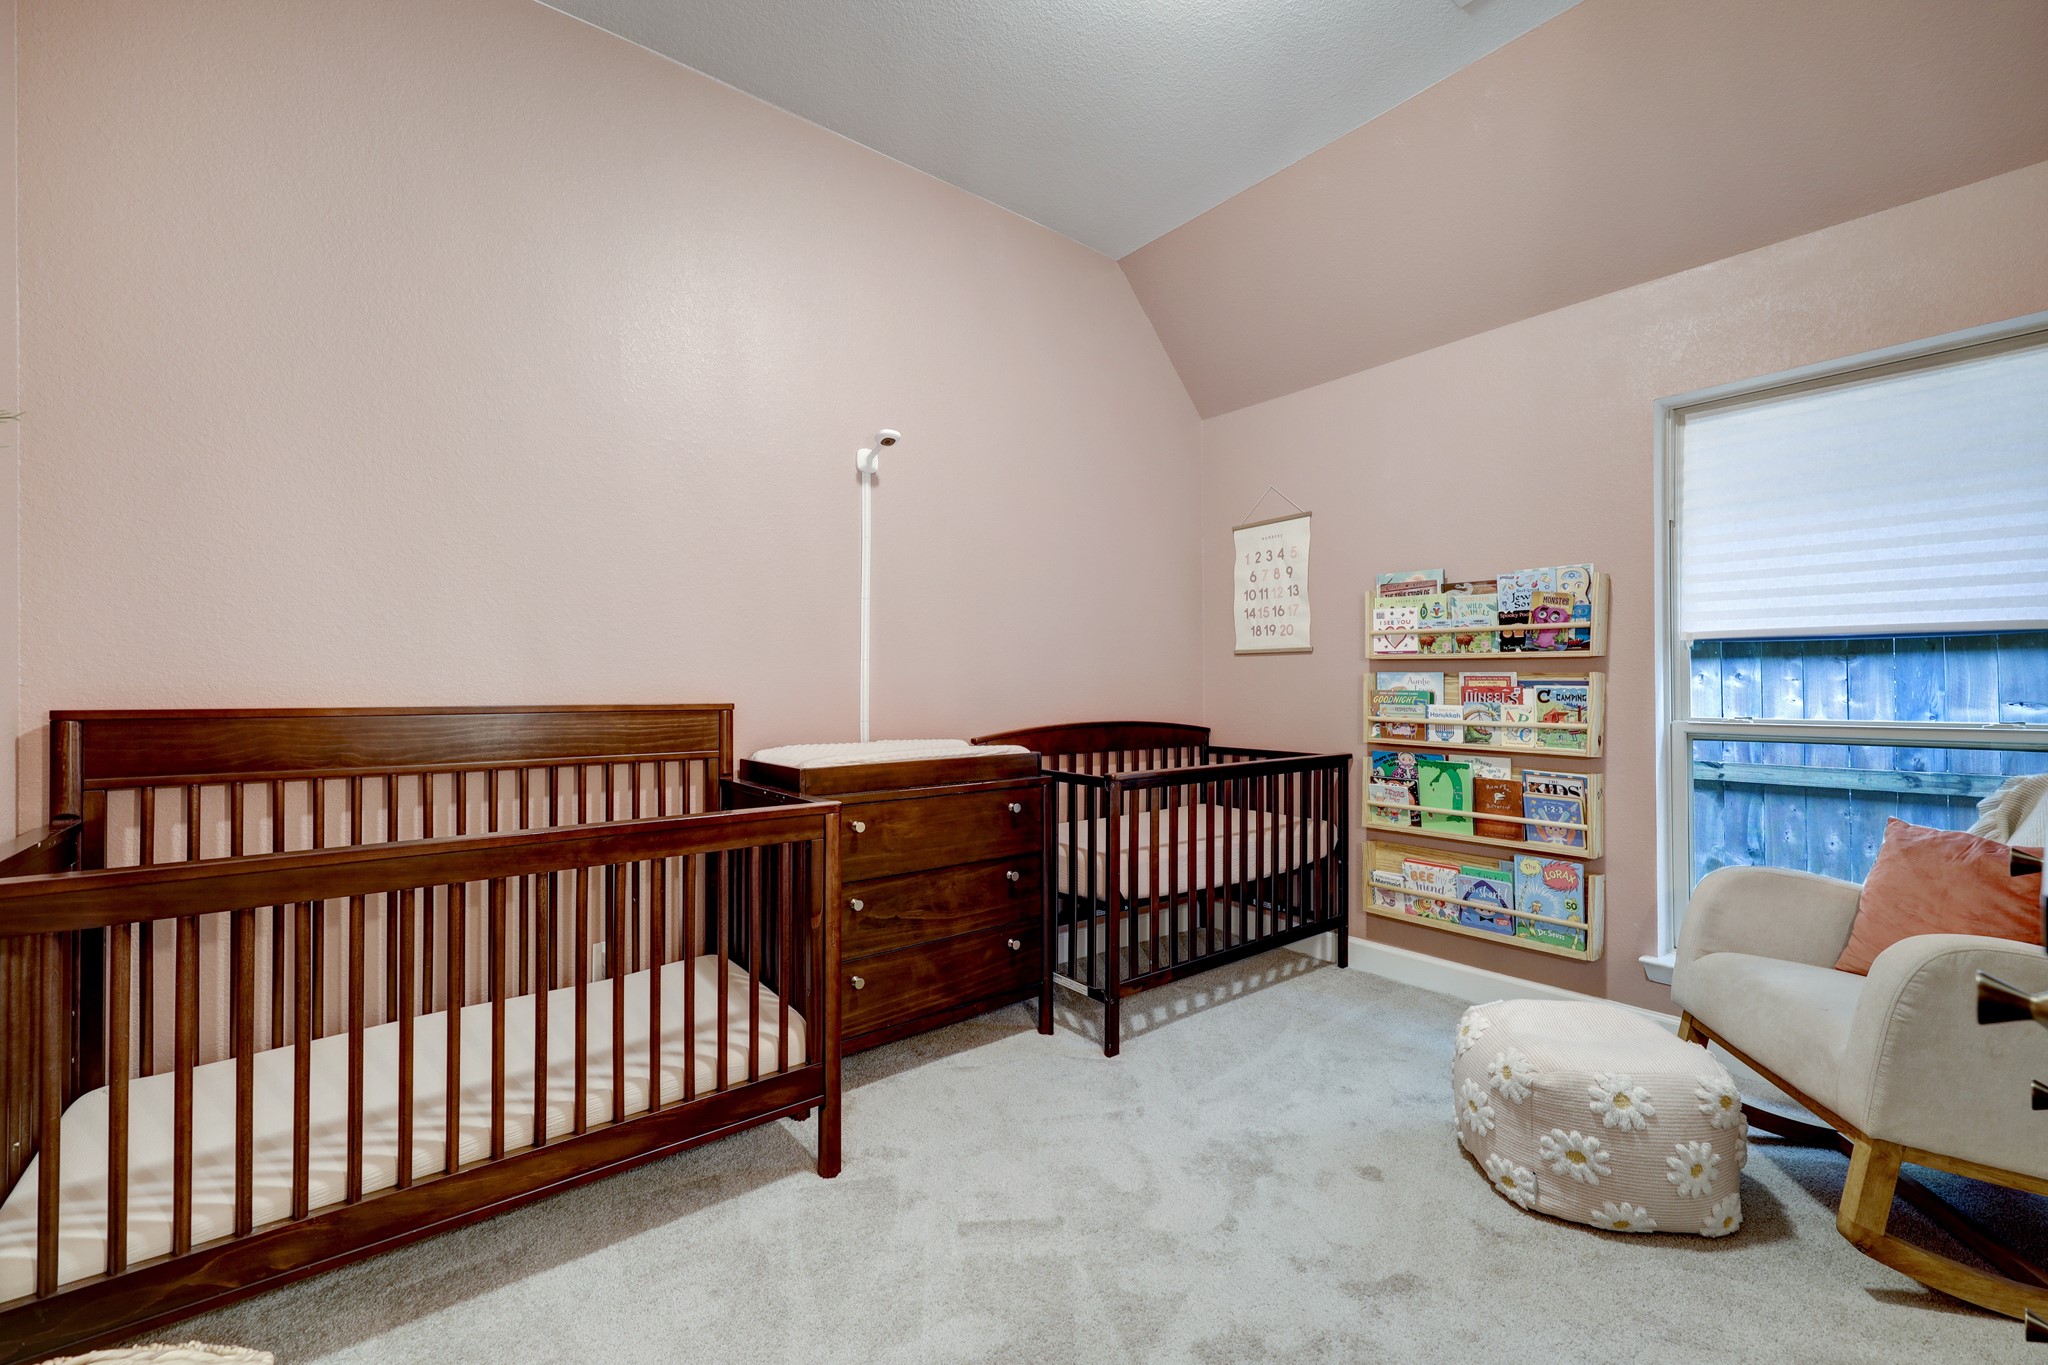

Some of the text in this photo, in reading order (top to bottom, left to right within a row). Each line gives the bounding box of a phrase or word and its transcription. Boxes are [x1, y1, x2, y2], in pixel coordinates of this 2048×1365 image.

[1245, 546, 1297, 565] 1 2 3 4 5
[1249, 566, 1293, 583] 6 7 8 9
[1244, 584, 1299, 601] 10 11 12 13
[1511, 592, 1531, 603] Jew
[1244, 603, 1300, 620] 14 15 16 17
[1466, 602, 1483, 610] WILD
[1461, 609, 1490, 618] ANIMALS
[1251, 624, 1294, 637] 18 19 20
[1407, 676, 1431, 686] Auntie
[1373, 695, 1418, 704] GOODNIGHT
[1537, 689, 1551, 703] C
[1556, 694, 1587, 702] CAMPING
[1520, 727, 1533, 743] C
[1385, 788, 1405, 798] TEXAS
[1410, 870, 1435, 883] BEE
[1524, 863, 1577, 884] The LORAX
[1375, 878, 1401, 888] Mermaid
[1566, 902, 1578, 911] 50
[1548, 930, 1565, 940] Seuss
